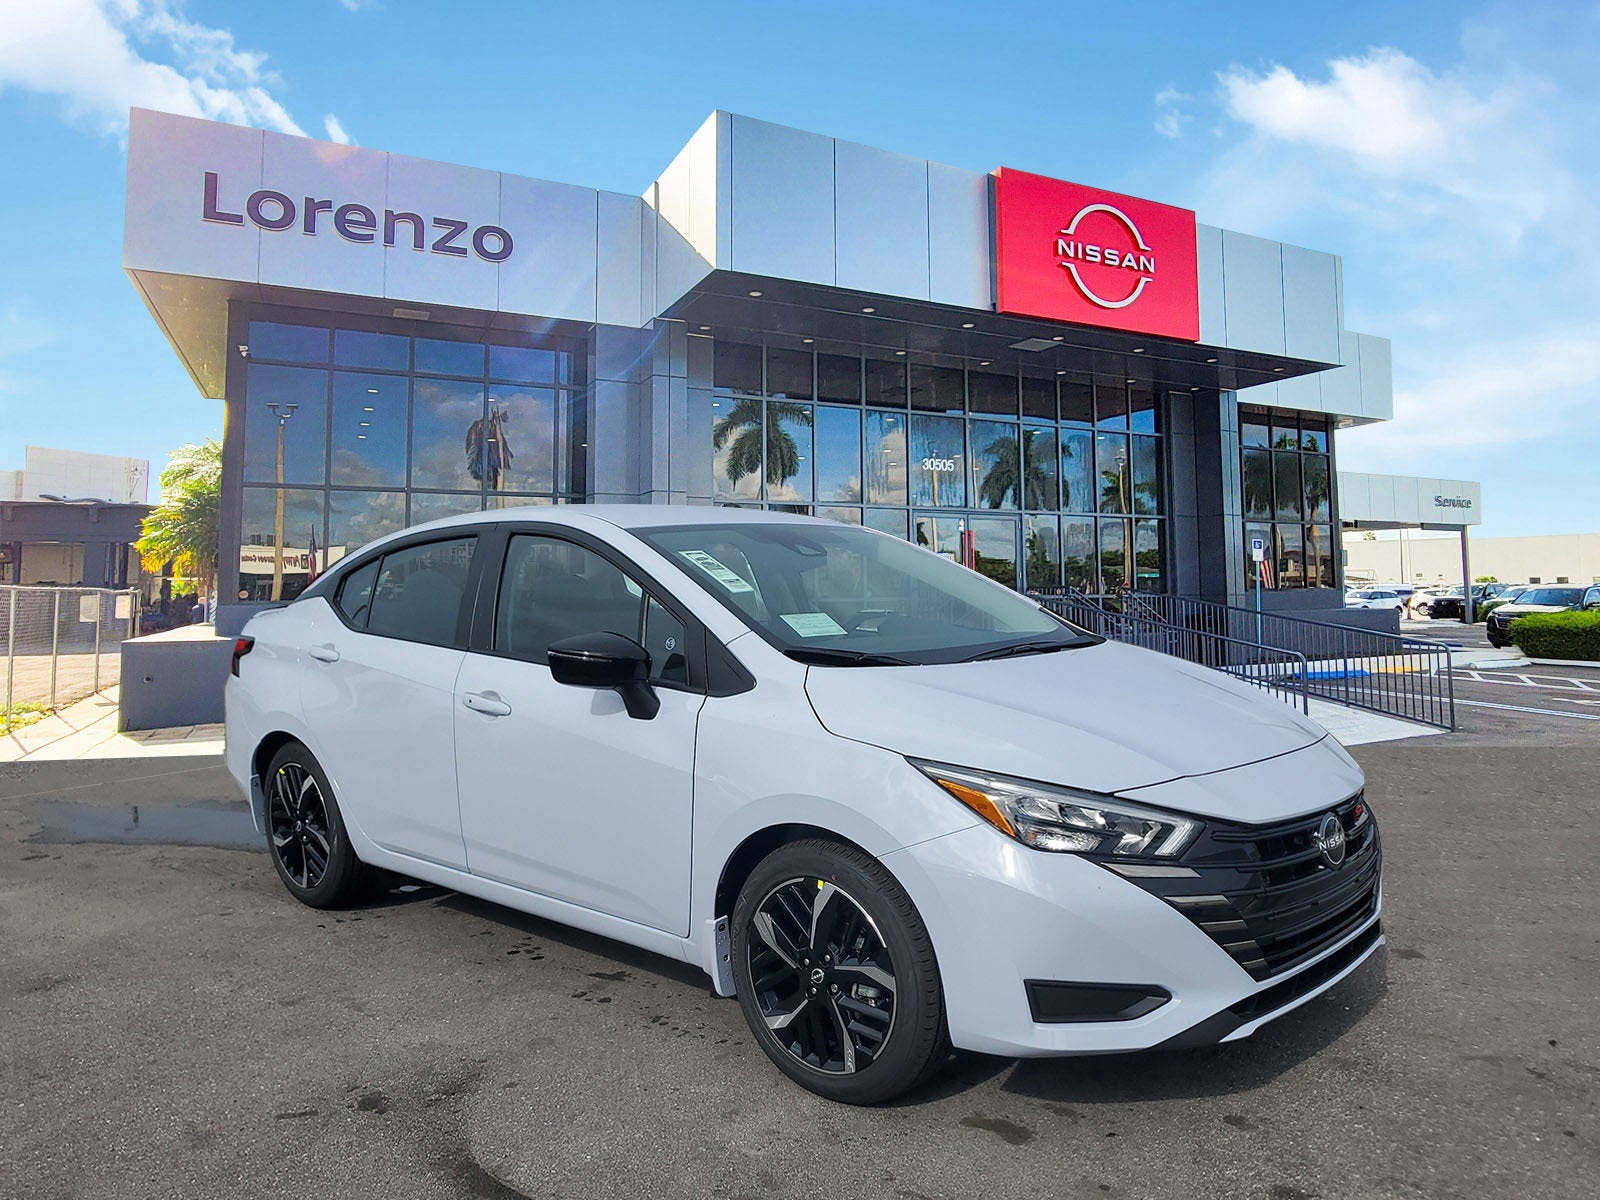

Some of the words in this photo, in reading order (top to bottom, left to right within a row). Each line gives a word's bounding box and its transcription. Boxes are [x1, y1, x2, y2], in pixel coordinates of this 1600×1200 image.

[203, 171, 514, 262] Lorenzo
[1057, 238, 1155, 273] NISSAN
[922, 458, 954, 471] 30505
[1434, 495, 1472, 508] Service
[1319, 833, 1345, 850] NISS
